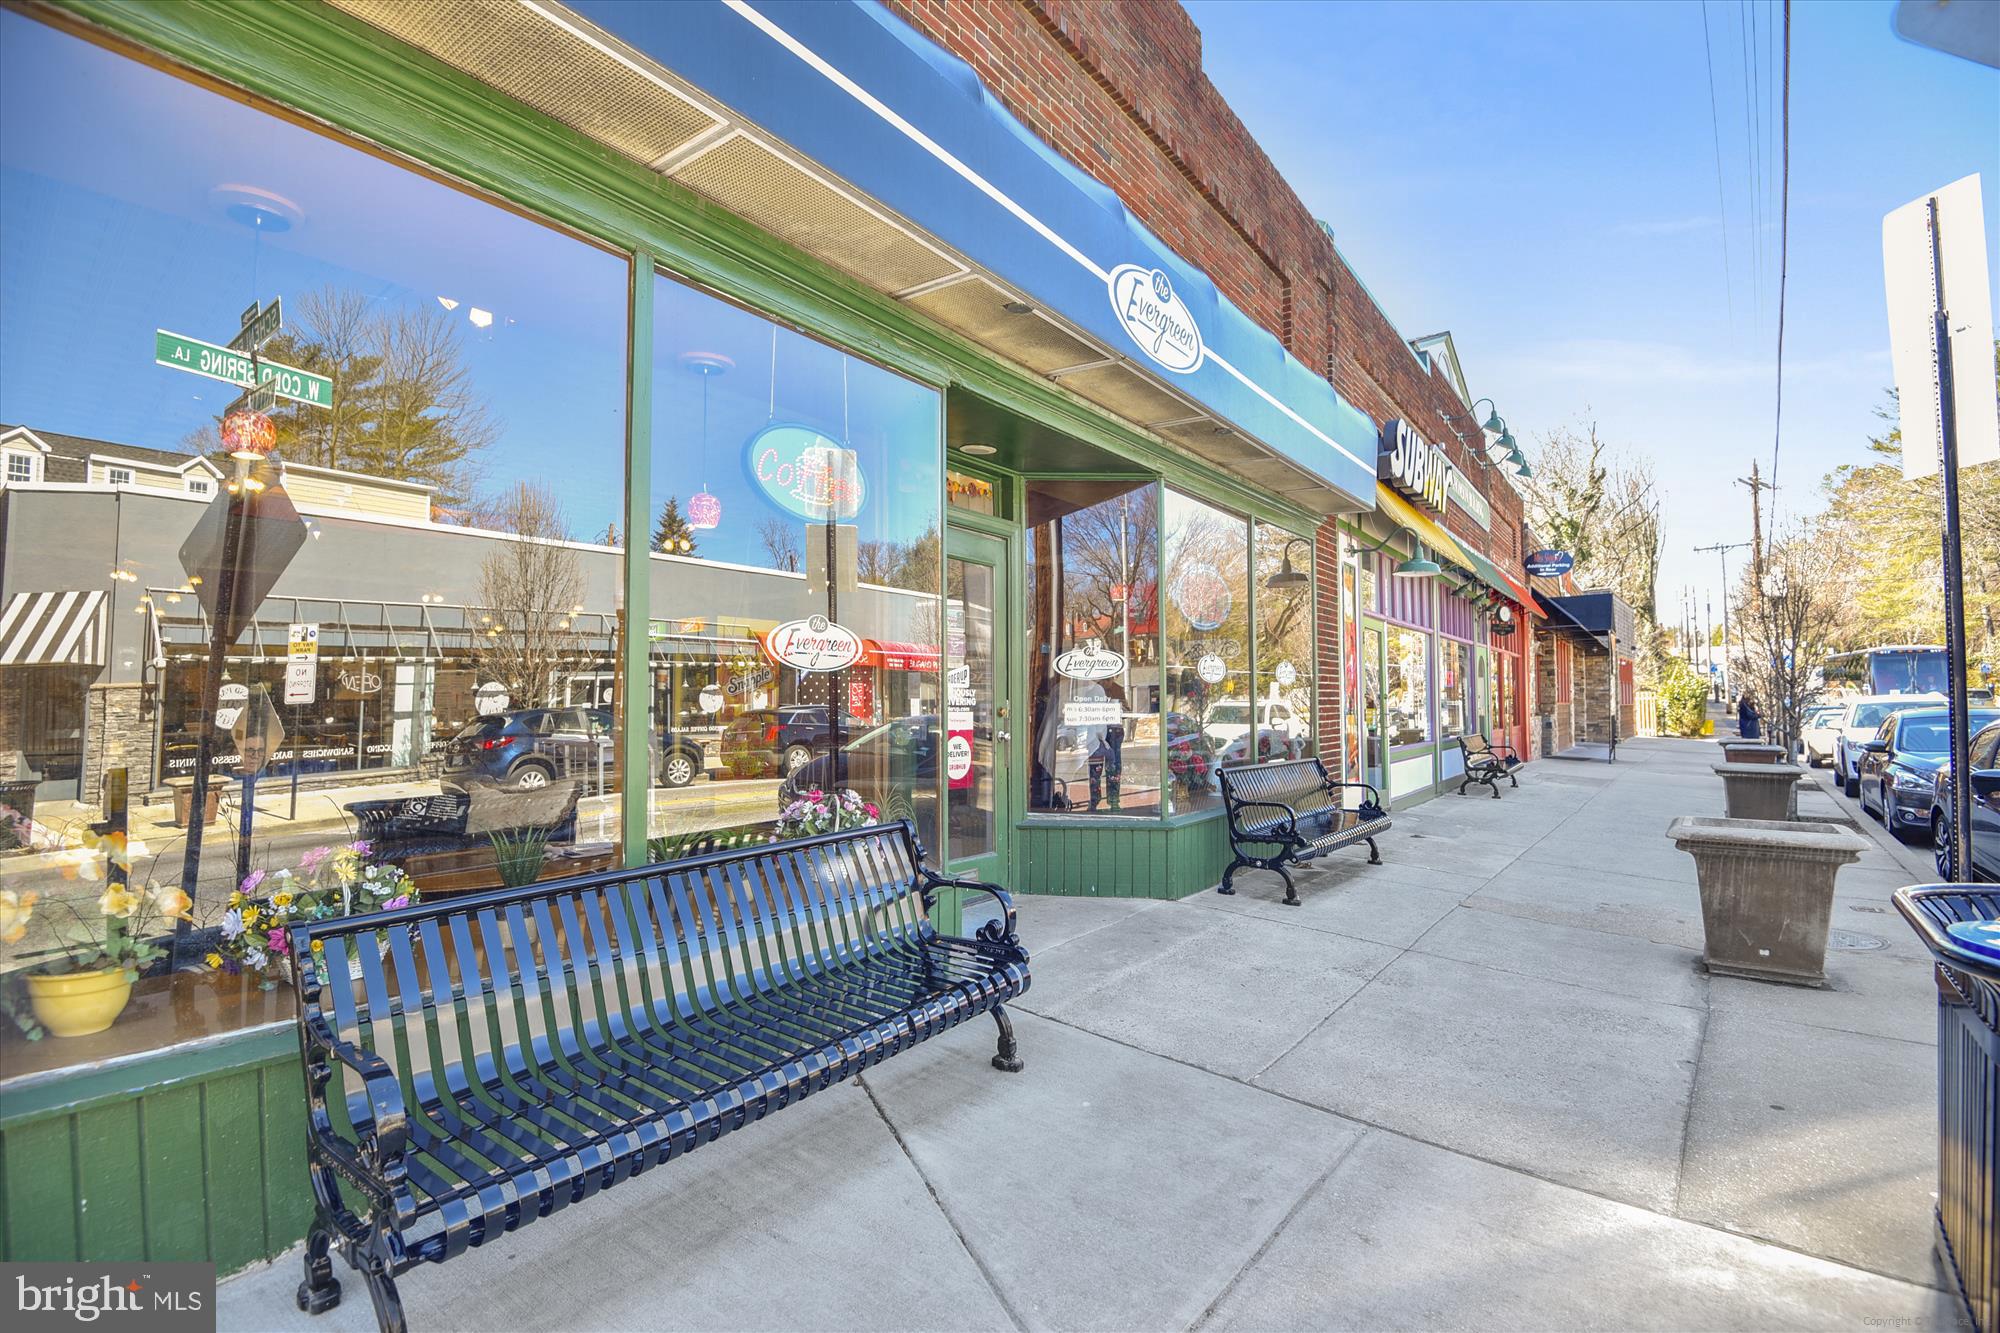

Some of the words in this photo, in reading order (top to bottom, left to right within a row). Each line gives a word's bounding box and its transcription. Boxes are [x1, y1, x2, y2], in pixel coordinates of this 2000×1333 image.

[1154, 274, 1169, 300] the
[1126, 277, 1194, 354] Evergreen
[1390, 418, 1452, 514] SUBWAY
[811, 616, 827, 630] the
[785, 628, 851, 667] Evergreen
[1065, 655, 1120, 677] Evergreen
[1073, 695, 1092, 703] Open
[1094, 695, 1111, 703] Daily
